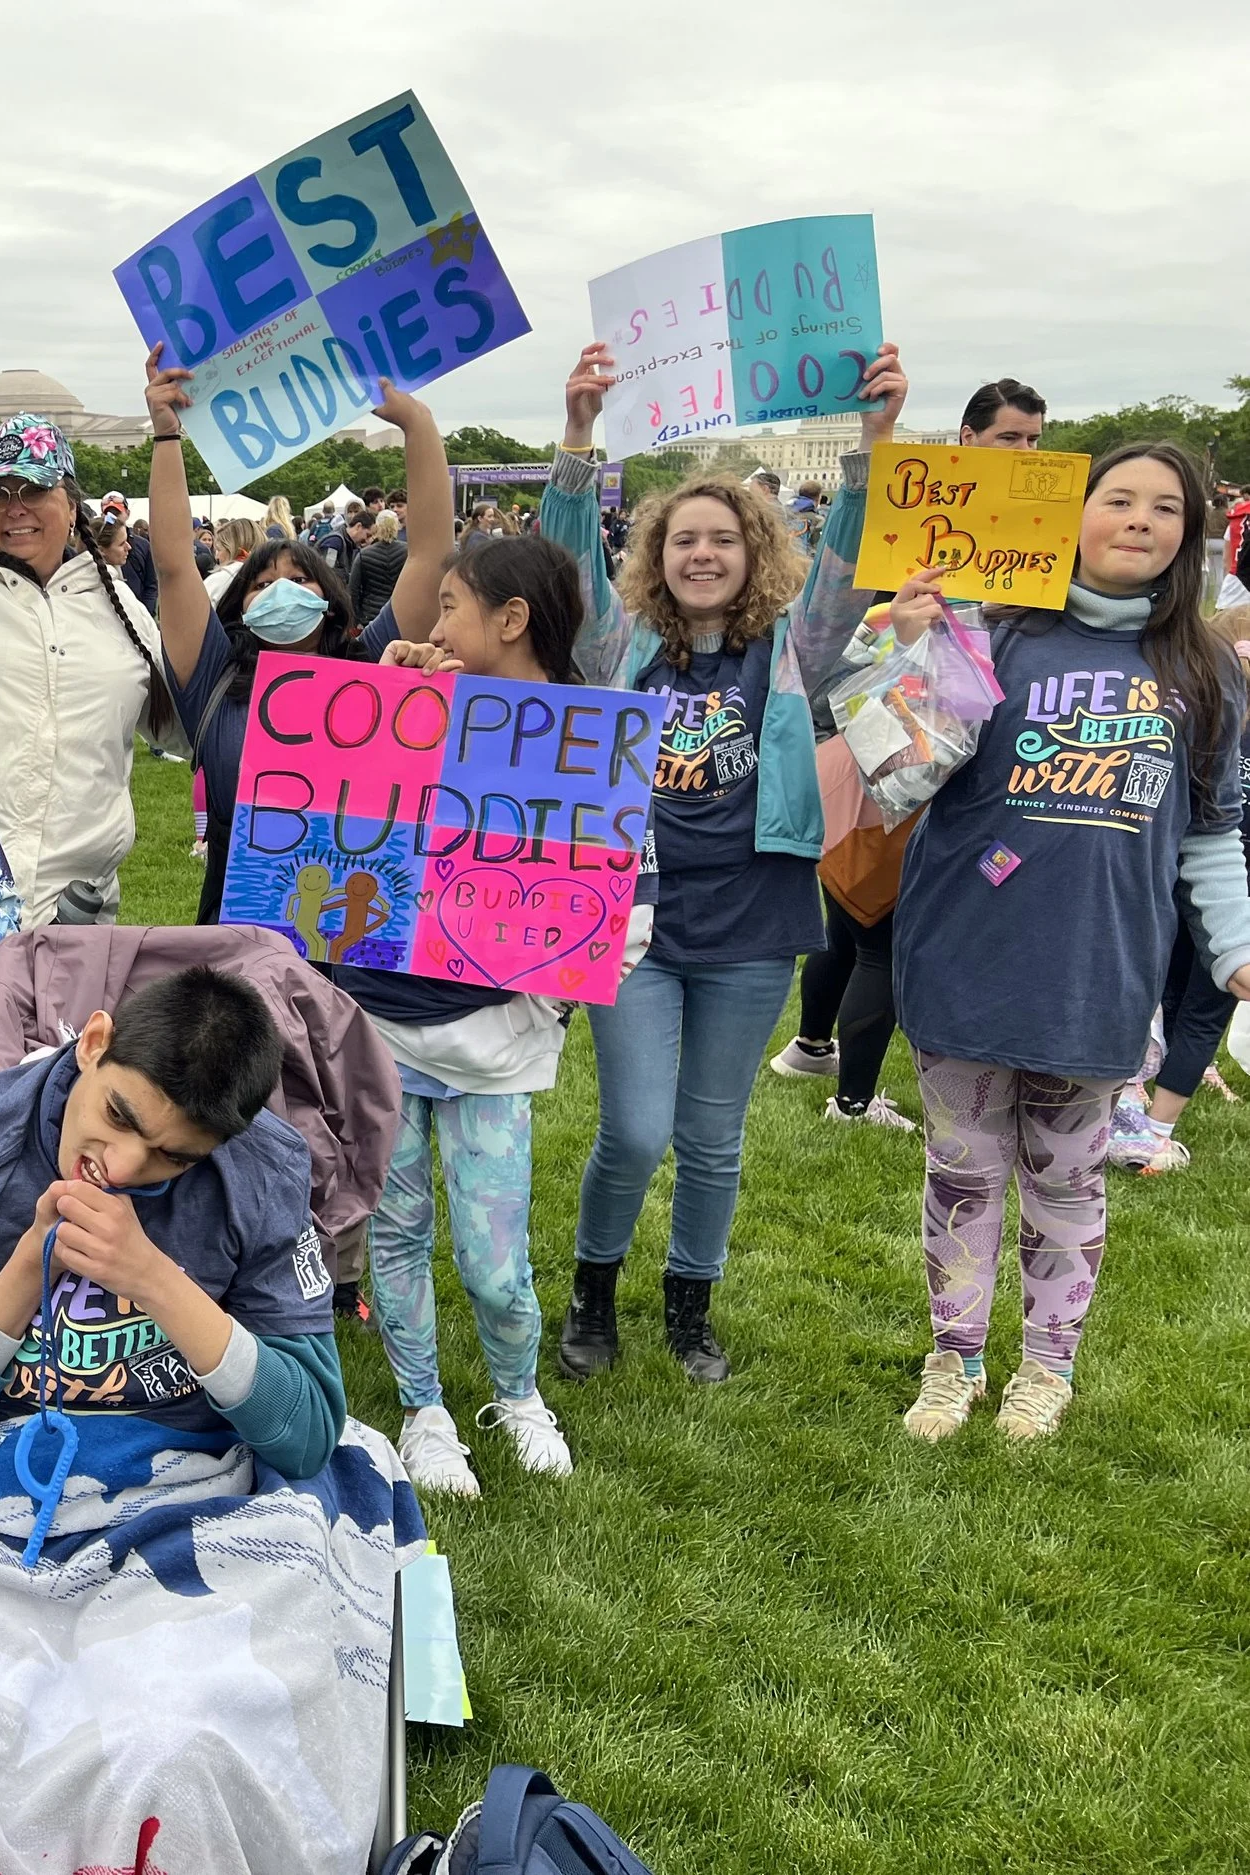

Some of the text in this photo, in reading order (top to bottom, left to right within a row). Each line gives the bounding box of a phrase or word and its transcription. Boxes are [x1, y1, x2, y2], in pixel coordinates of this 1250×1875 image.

[137, 103, 437, 367] BEST
[336, 248, 394, 281] COOPER
[627, 246, 844, 345] BUDDIES
[222, 307, 299, 360] SIBLINGS OF
[236, 322, 320, 377] EXCEPTIONAL
[253, 338, 273, 355] THE
[791, 314, 862, 336] Siblings
[616, 346, 703, 383] Exception
[647, 350, 866, 427] COOPER
[1025, 670, 1125, 723] LIFE
[258, 670, 650, 787] COOPPER
[1079, 717, 1165, 743] BETTER
[654, 749, 710, 791] ith
[1007, 750, 1131, 800] with
[247, 770, 645, 872] BUDDIES
[1005, 798, 1045, 809] SERVICE
[1056, 803, 1104, 814] KINDNESS
[456, 881, 599, 917] BUDDIES
